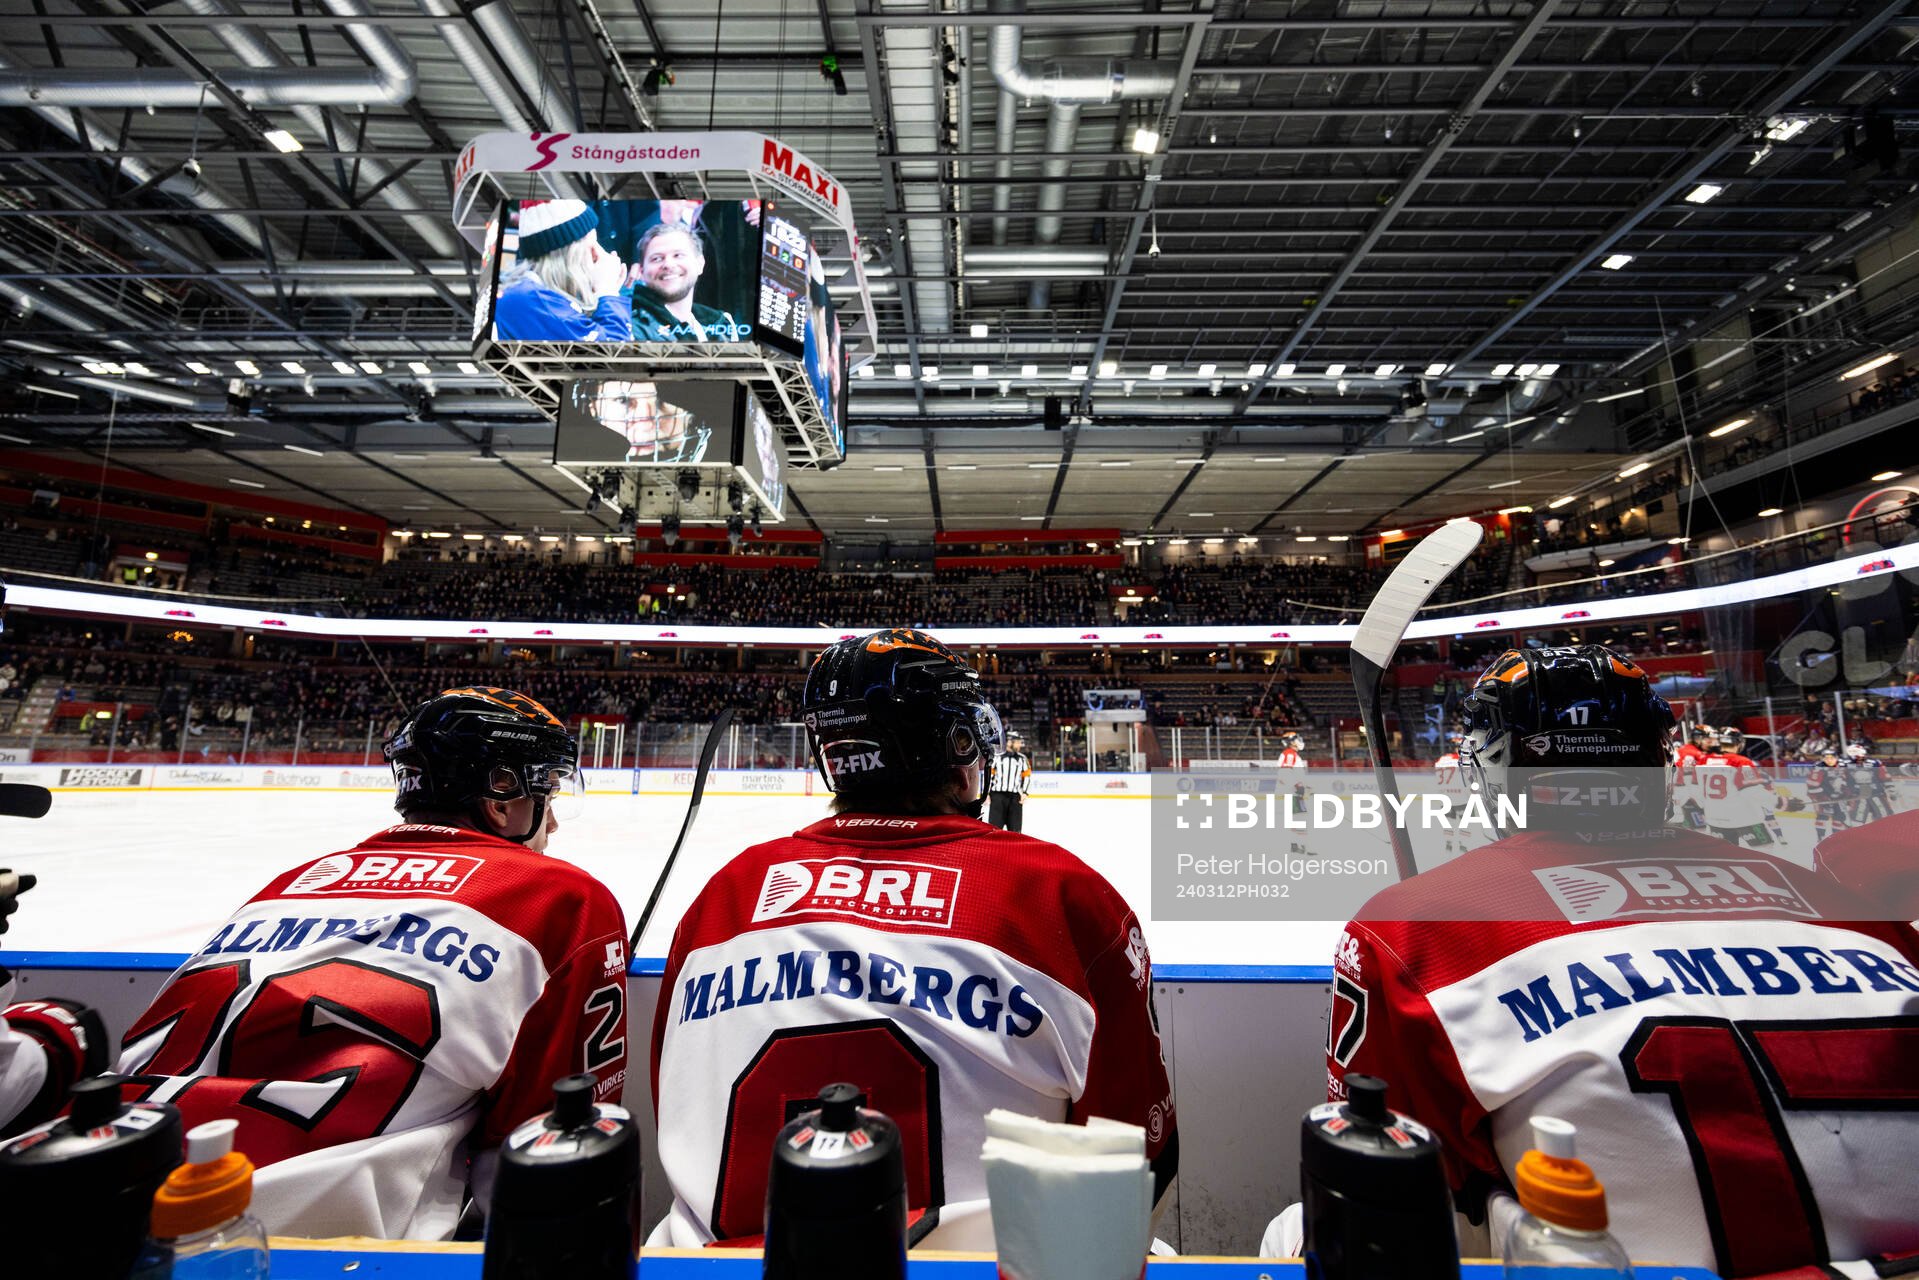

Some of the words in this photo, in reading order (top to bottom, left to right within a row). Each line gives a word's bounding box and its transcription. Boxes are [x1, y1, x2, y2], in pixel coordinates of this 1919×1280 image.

[571, 144, 700, 163] Stångåstaden
[763, 138, 838, 207] MAXI
[828, 679, 838, 697] 9
[817, 708, 845, 718] Thermia
[818, 713, 868, 728] Värmepumpar
[1568, 706, 1590, 725] 17
[490, 730, 538, 742] BAUER
[1554, 734, 1606, 743] Thermia
[1555, 743, 1641, 754] Värmepumpar
[66, 768, 137, 784] HOCKEY
[846, 818, 918, 829] BAUER
[348, 856, 458, 882] BRL
[341, 881, 451, 889] ELECTRONICS
[814, 864, 946, 909] BRL
[1616, 865, 1795, 899] BRL
[811, 898, 944, 918] ELECTRONICS
[1646, 897, 1803, 908] ELECTRONICS
[192, 912, 500, 983] ALMBERGS
[679, 950, 1046, 1039] MALMBERGS
